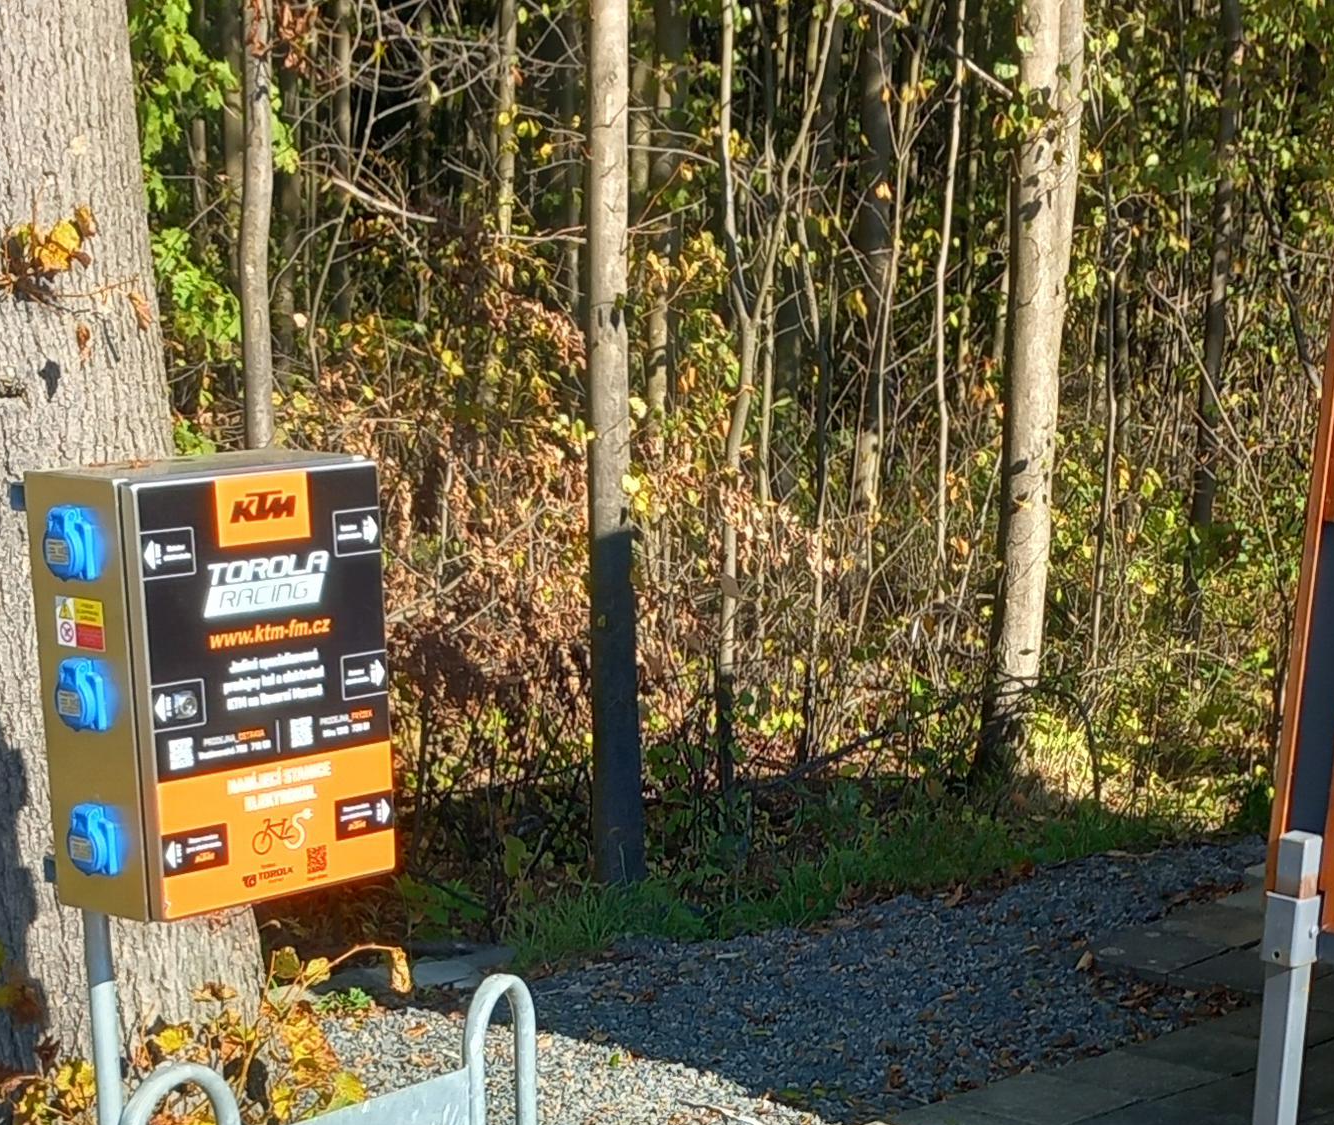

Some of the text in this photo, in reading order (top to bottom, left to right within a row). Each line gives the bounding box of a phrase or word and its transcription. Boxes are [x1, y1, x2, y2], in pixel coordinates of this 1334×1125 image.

[229, 489, 297, 524] KTM
[207, 550, 330, 586] TOROLA
[219, 580, 308, 608] RACING
[209, 618, 331, 649] www.ktm-fm.cz
